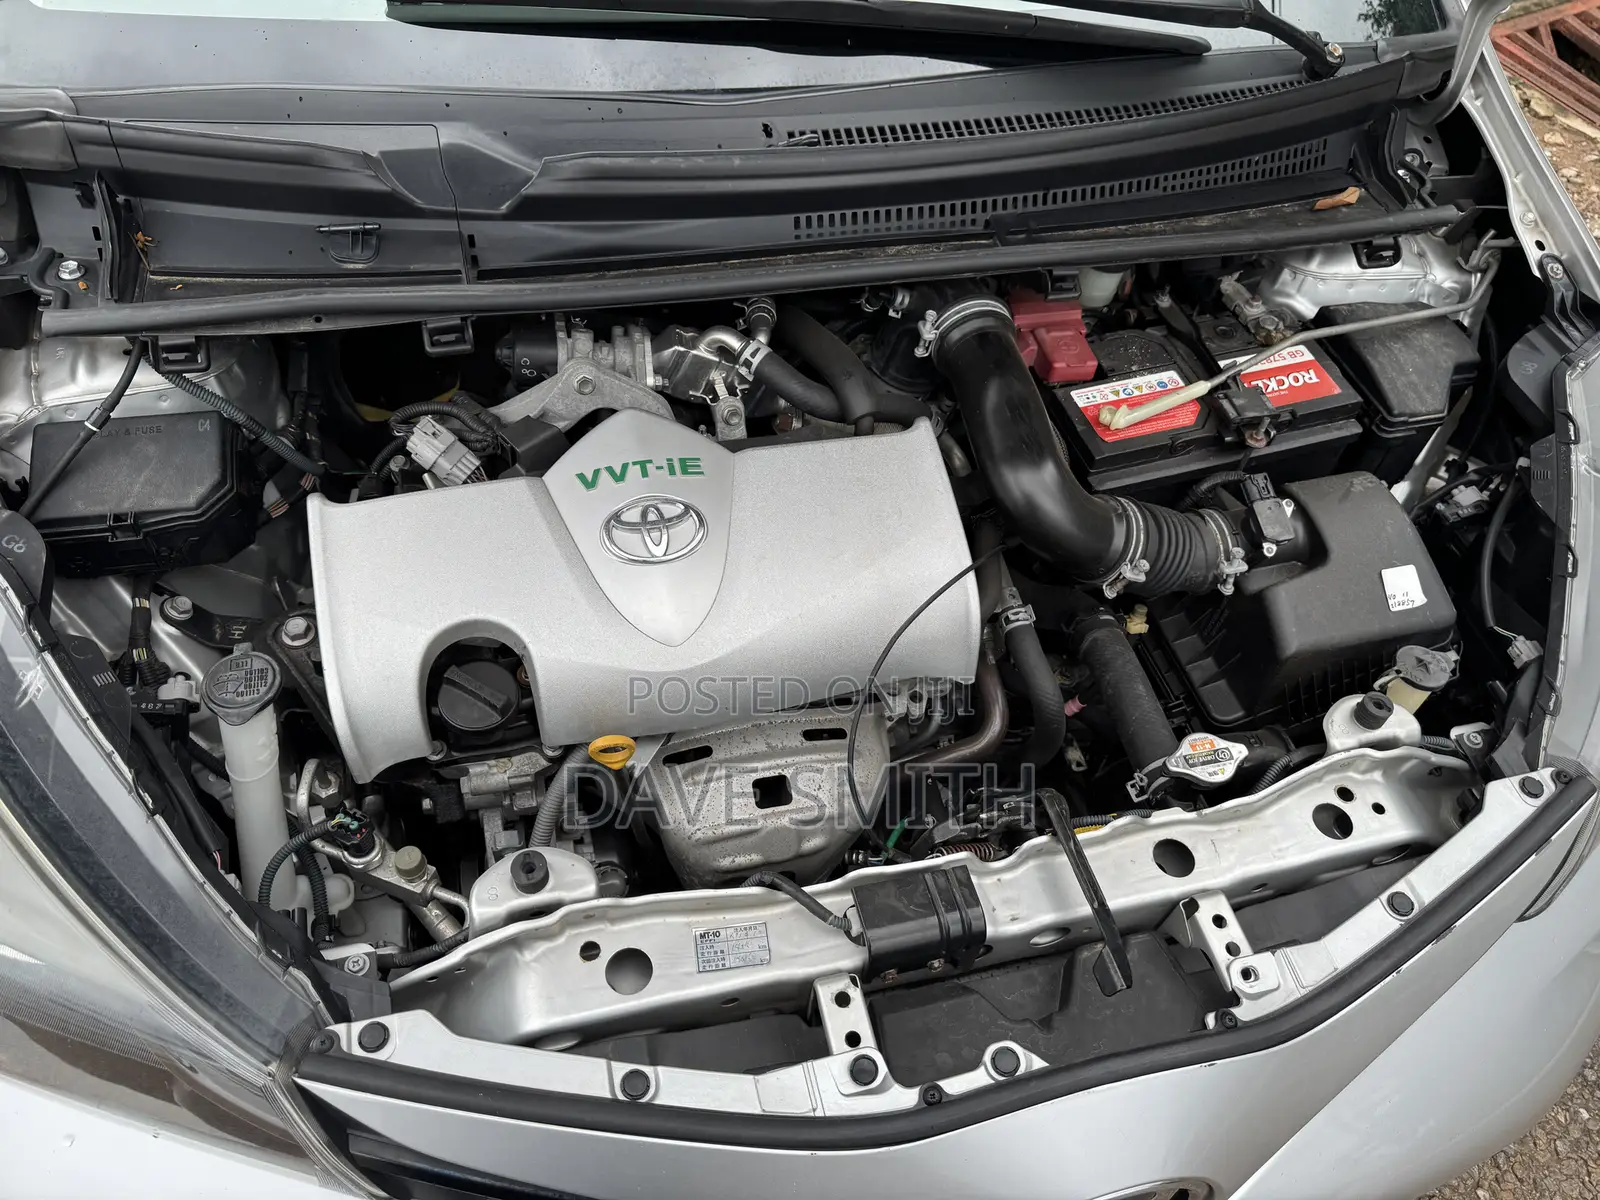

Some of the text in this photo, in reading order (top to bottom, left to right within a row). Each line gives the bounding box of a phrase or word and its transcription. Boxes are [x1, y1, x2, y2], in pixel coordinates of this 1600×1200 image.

[1286, 349, 1305, 359] GB
[1243, 369, 1320, 393] ROCK
[134, 425, 163, 436] FUSE
[575, 457, 705, 492] VVT-iE
[699, 931, 721, 939] MT-10
